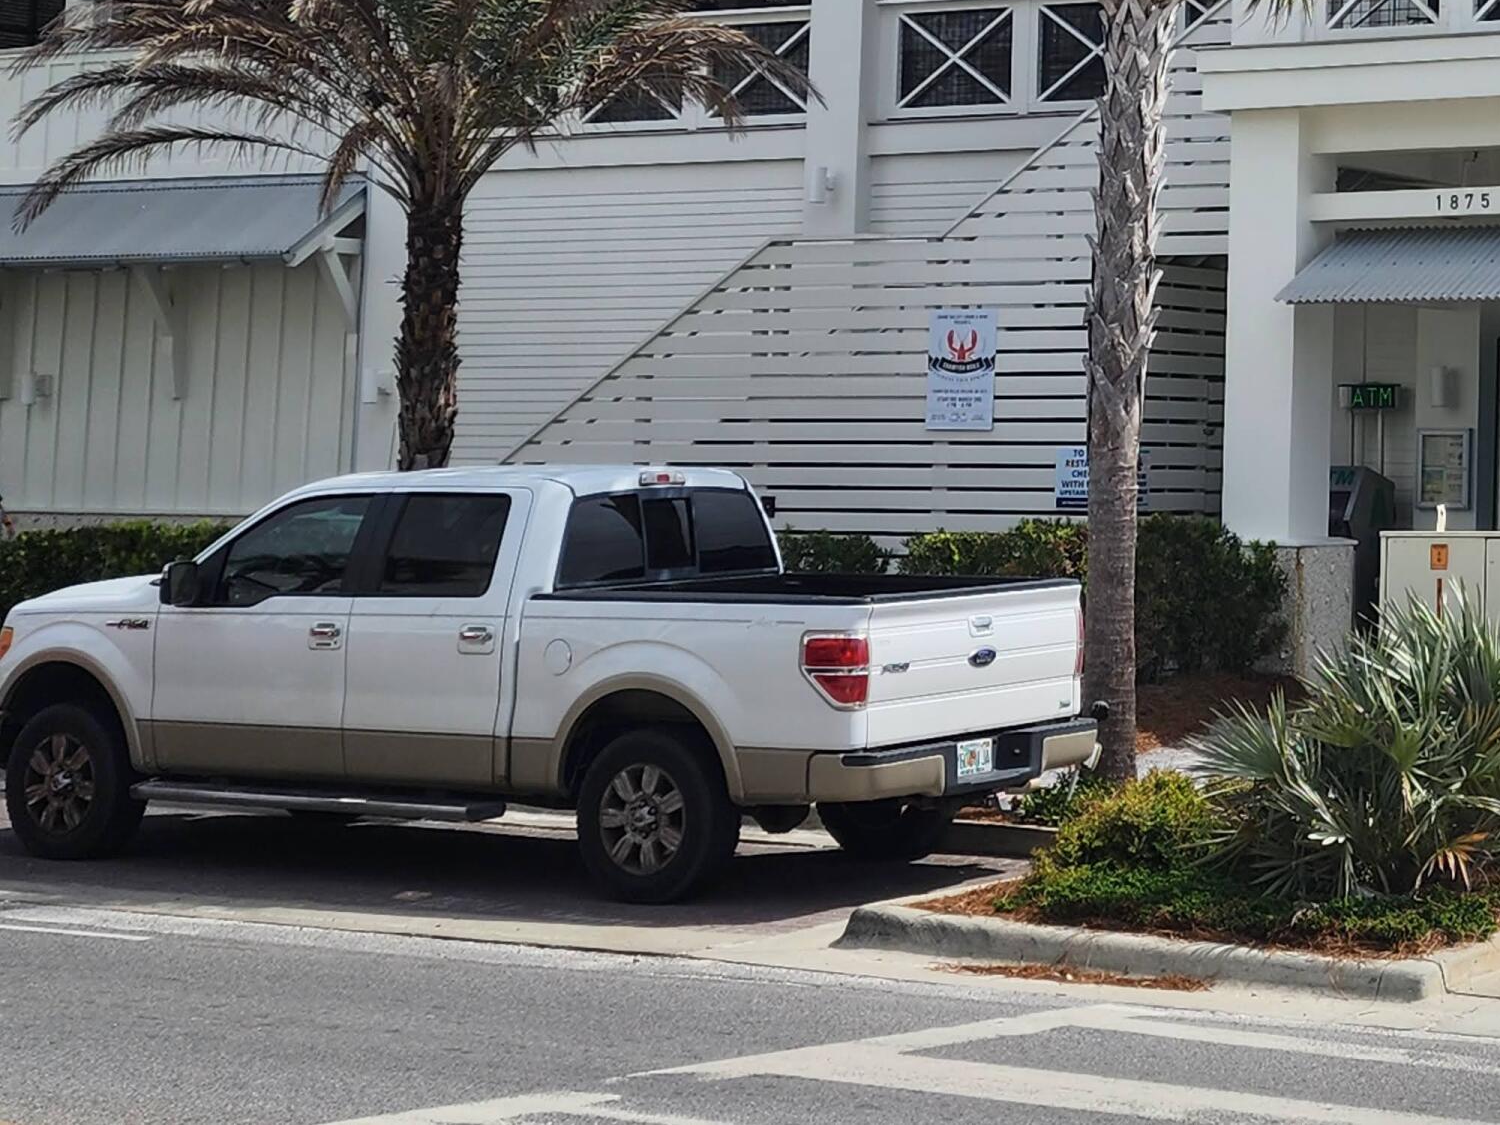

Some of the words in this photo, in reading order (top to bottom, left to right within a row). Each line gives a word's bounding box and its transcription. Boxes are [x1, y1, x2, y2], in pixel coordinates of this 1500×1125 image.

[1436, 193, 1490, 211] 1875
[1353, 387, 1393, 407] ATM
[1073, 449, 1085, 457] TO
[1061, 480, 1084, 488] WITH
